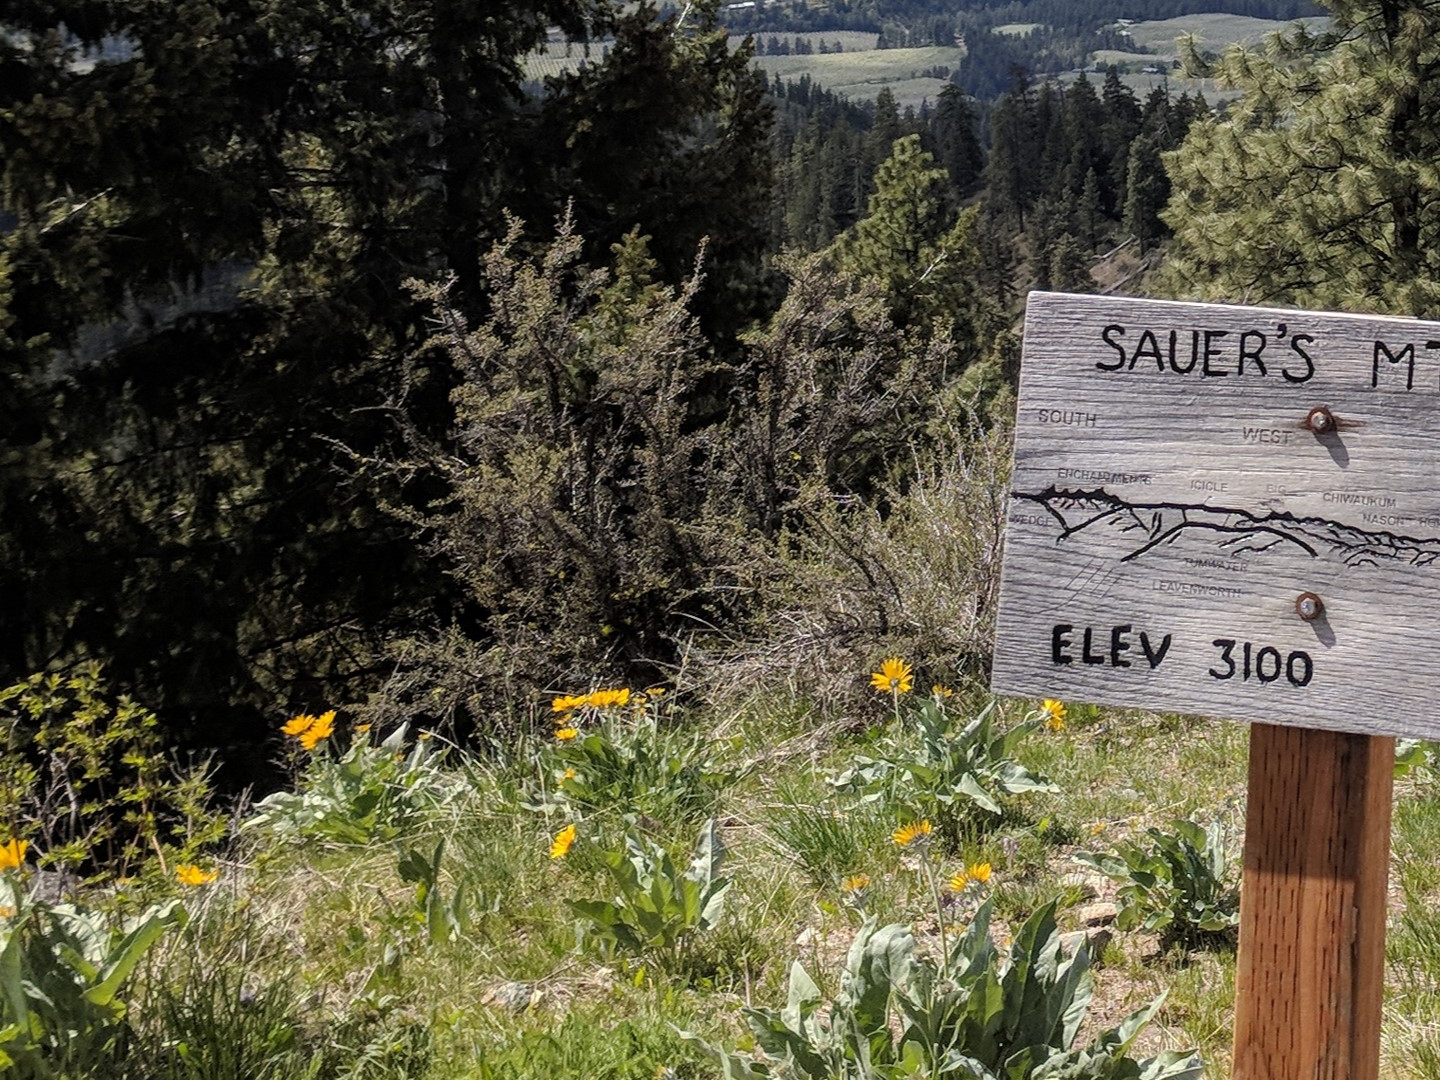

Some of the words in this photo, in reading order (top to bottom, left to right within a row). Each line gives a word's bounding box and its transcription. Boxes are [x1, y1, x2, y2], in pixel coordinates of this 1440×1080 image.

[1097, 323, 1315, 383] SAUER'S
[1038, 408, 1097, 428] SOUTH
[1243, 426, 1293, 445] WEST
[1190, 479, 1228, 493] ICICLE
[1322, 492, 1397, 509] CHIWAUKUM
[1051, 624, 1172, 670] ELEV
[1209, 639, 1314, 687] 3100
